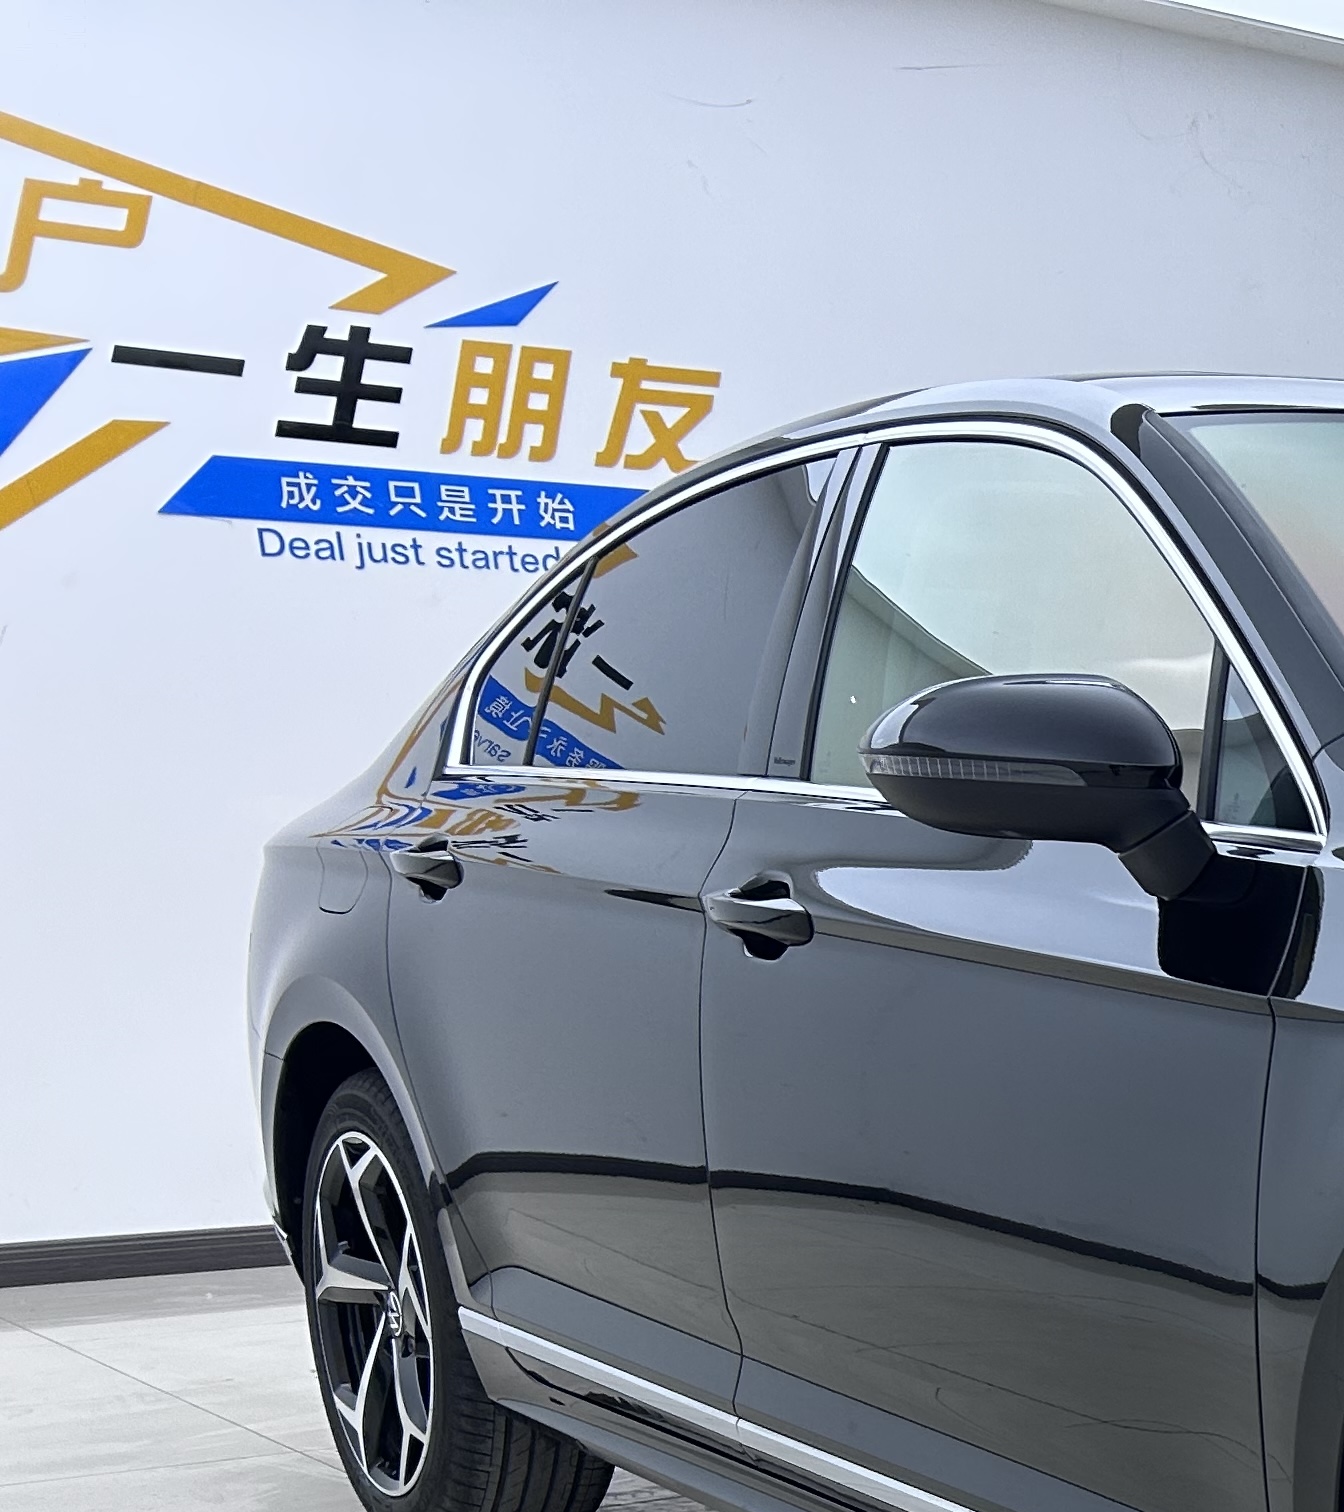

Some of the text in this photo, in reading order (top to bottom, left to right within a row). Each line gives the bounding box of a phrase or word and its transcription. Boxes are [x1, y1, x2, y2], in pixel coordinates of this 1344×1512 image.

[0, 177, 153, 293] 户
[111, 324, 722, 474] 一生朋友
[280, 471, 577, 532] 成交只是开始
[257, 527, 345, 561] Deal
[355, 533, 425, 570] just
